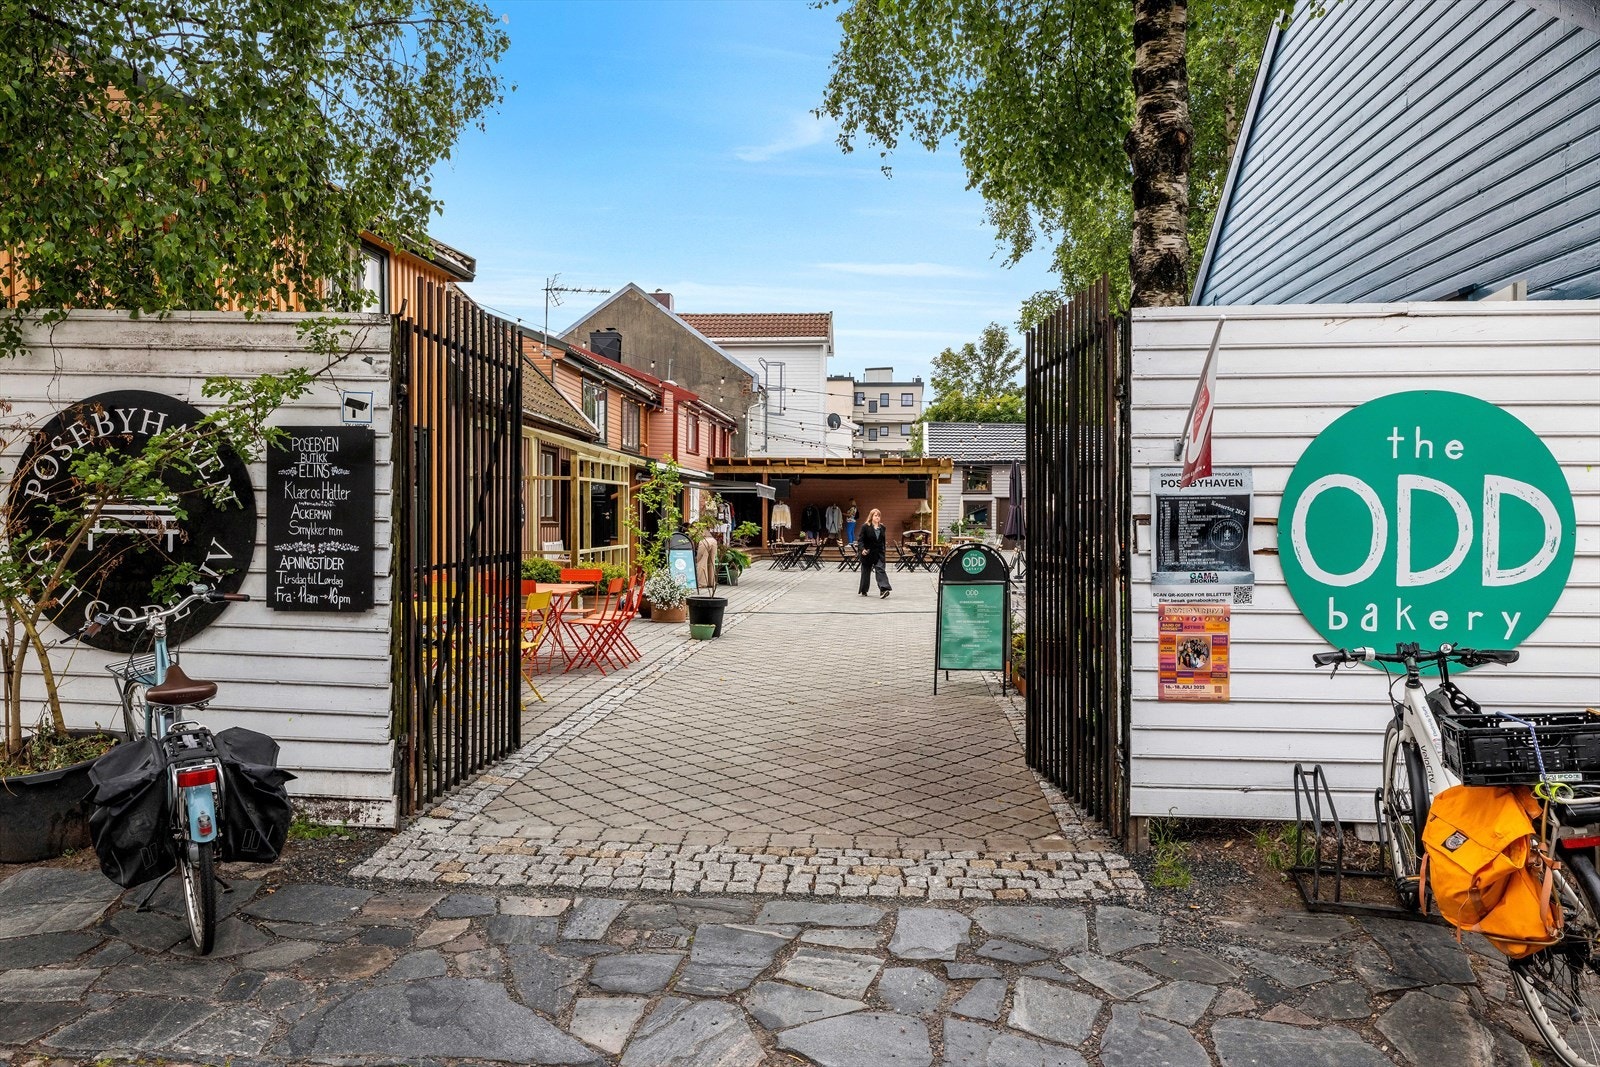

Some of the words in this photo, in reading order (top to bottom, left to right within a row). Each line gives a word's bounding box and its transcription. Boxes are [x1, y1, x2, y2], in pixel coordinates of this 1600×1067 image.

[291, 436, 339, 452] POSEBYEN
[1387, 426, 1464, 460] the
[300, 453, 328, 463] BUTIKK
[298, 463, 330, 479] ELINS
[1161, 479, 1243, 488] POSBYHAVEN
[288, 520, 328, 540] Smykker
[1291, 473, 1562, 587] ODD
[280, 555, 345, 570] ÅPNINGSTIDER
[962, 557, 986, 567] ODD
[275, 570, 306, 587] Tirsdag
[307, 572, 317, 585] til
[318, 571, 344, 588] Lørdag
[1190, 572, 1218, 580] GAMA
[1328, 597, 1521, 640] bakery
